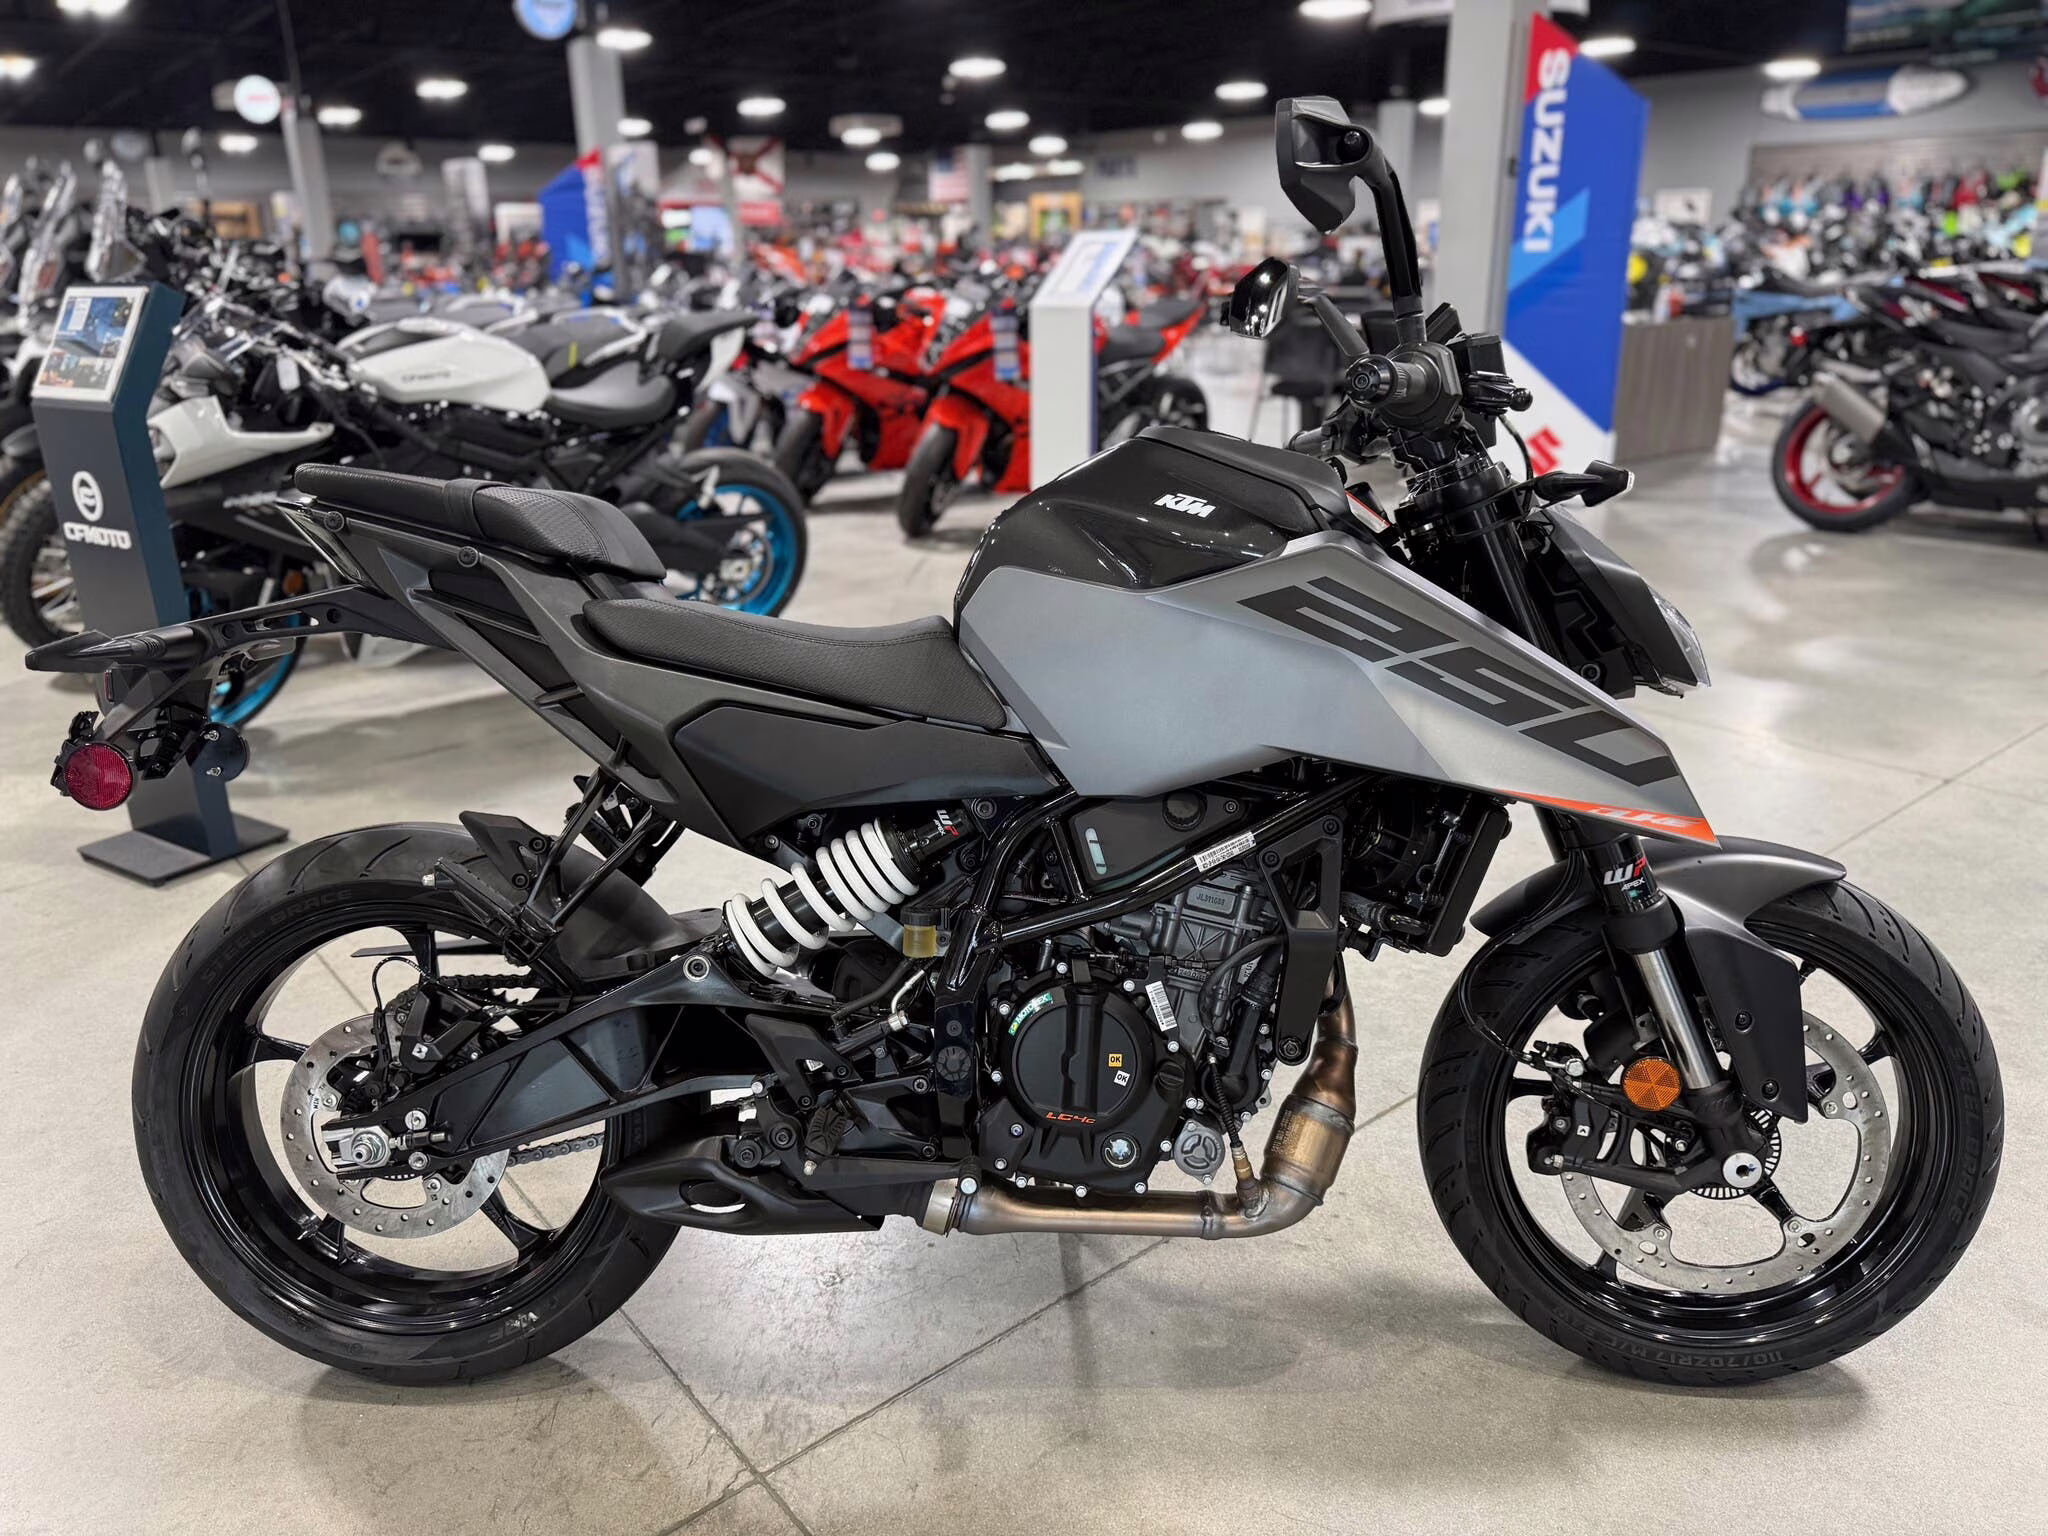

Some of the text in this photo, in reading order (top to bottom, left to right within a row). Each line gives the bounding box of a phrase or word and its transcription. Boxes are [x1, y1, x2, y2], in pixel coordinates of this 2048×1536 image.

[1523, 48, 1571, 252] SUZUKI
[1153, 493, 1217, 518] KTM
[63, 521, 132, 550] CFMOTO
[1236, 576, 1680, 787] 250
[1603, 856, 1647, 885] WP
[1620, 877, 1646, 892] APEX
[1116, 1074, 1127, 1083] OK
